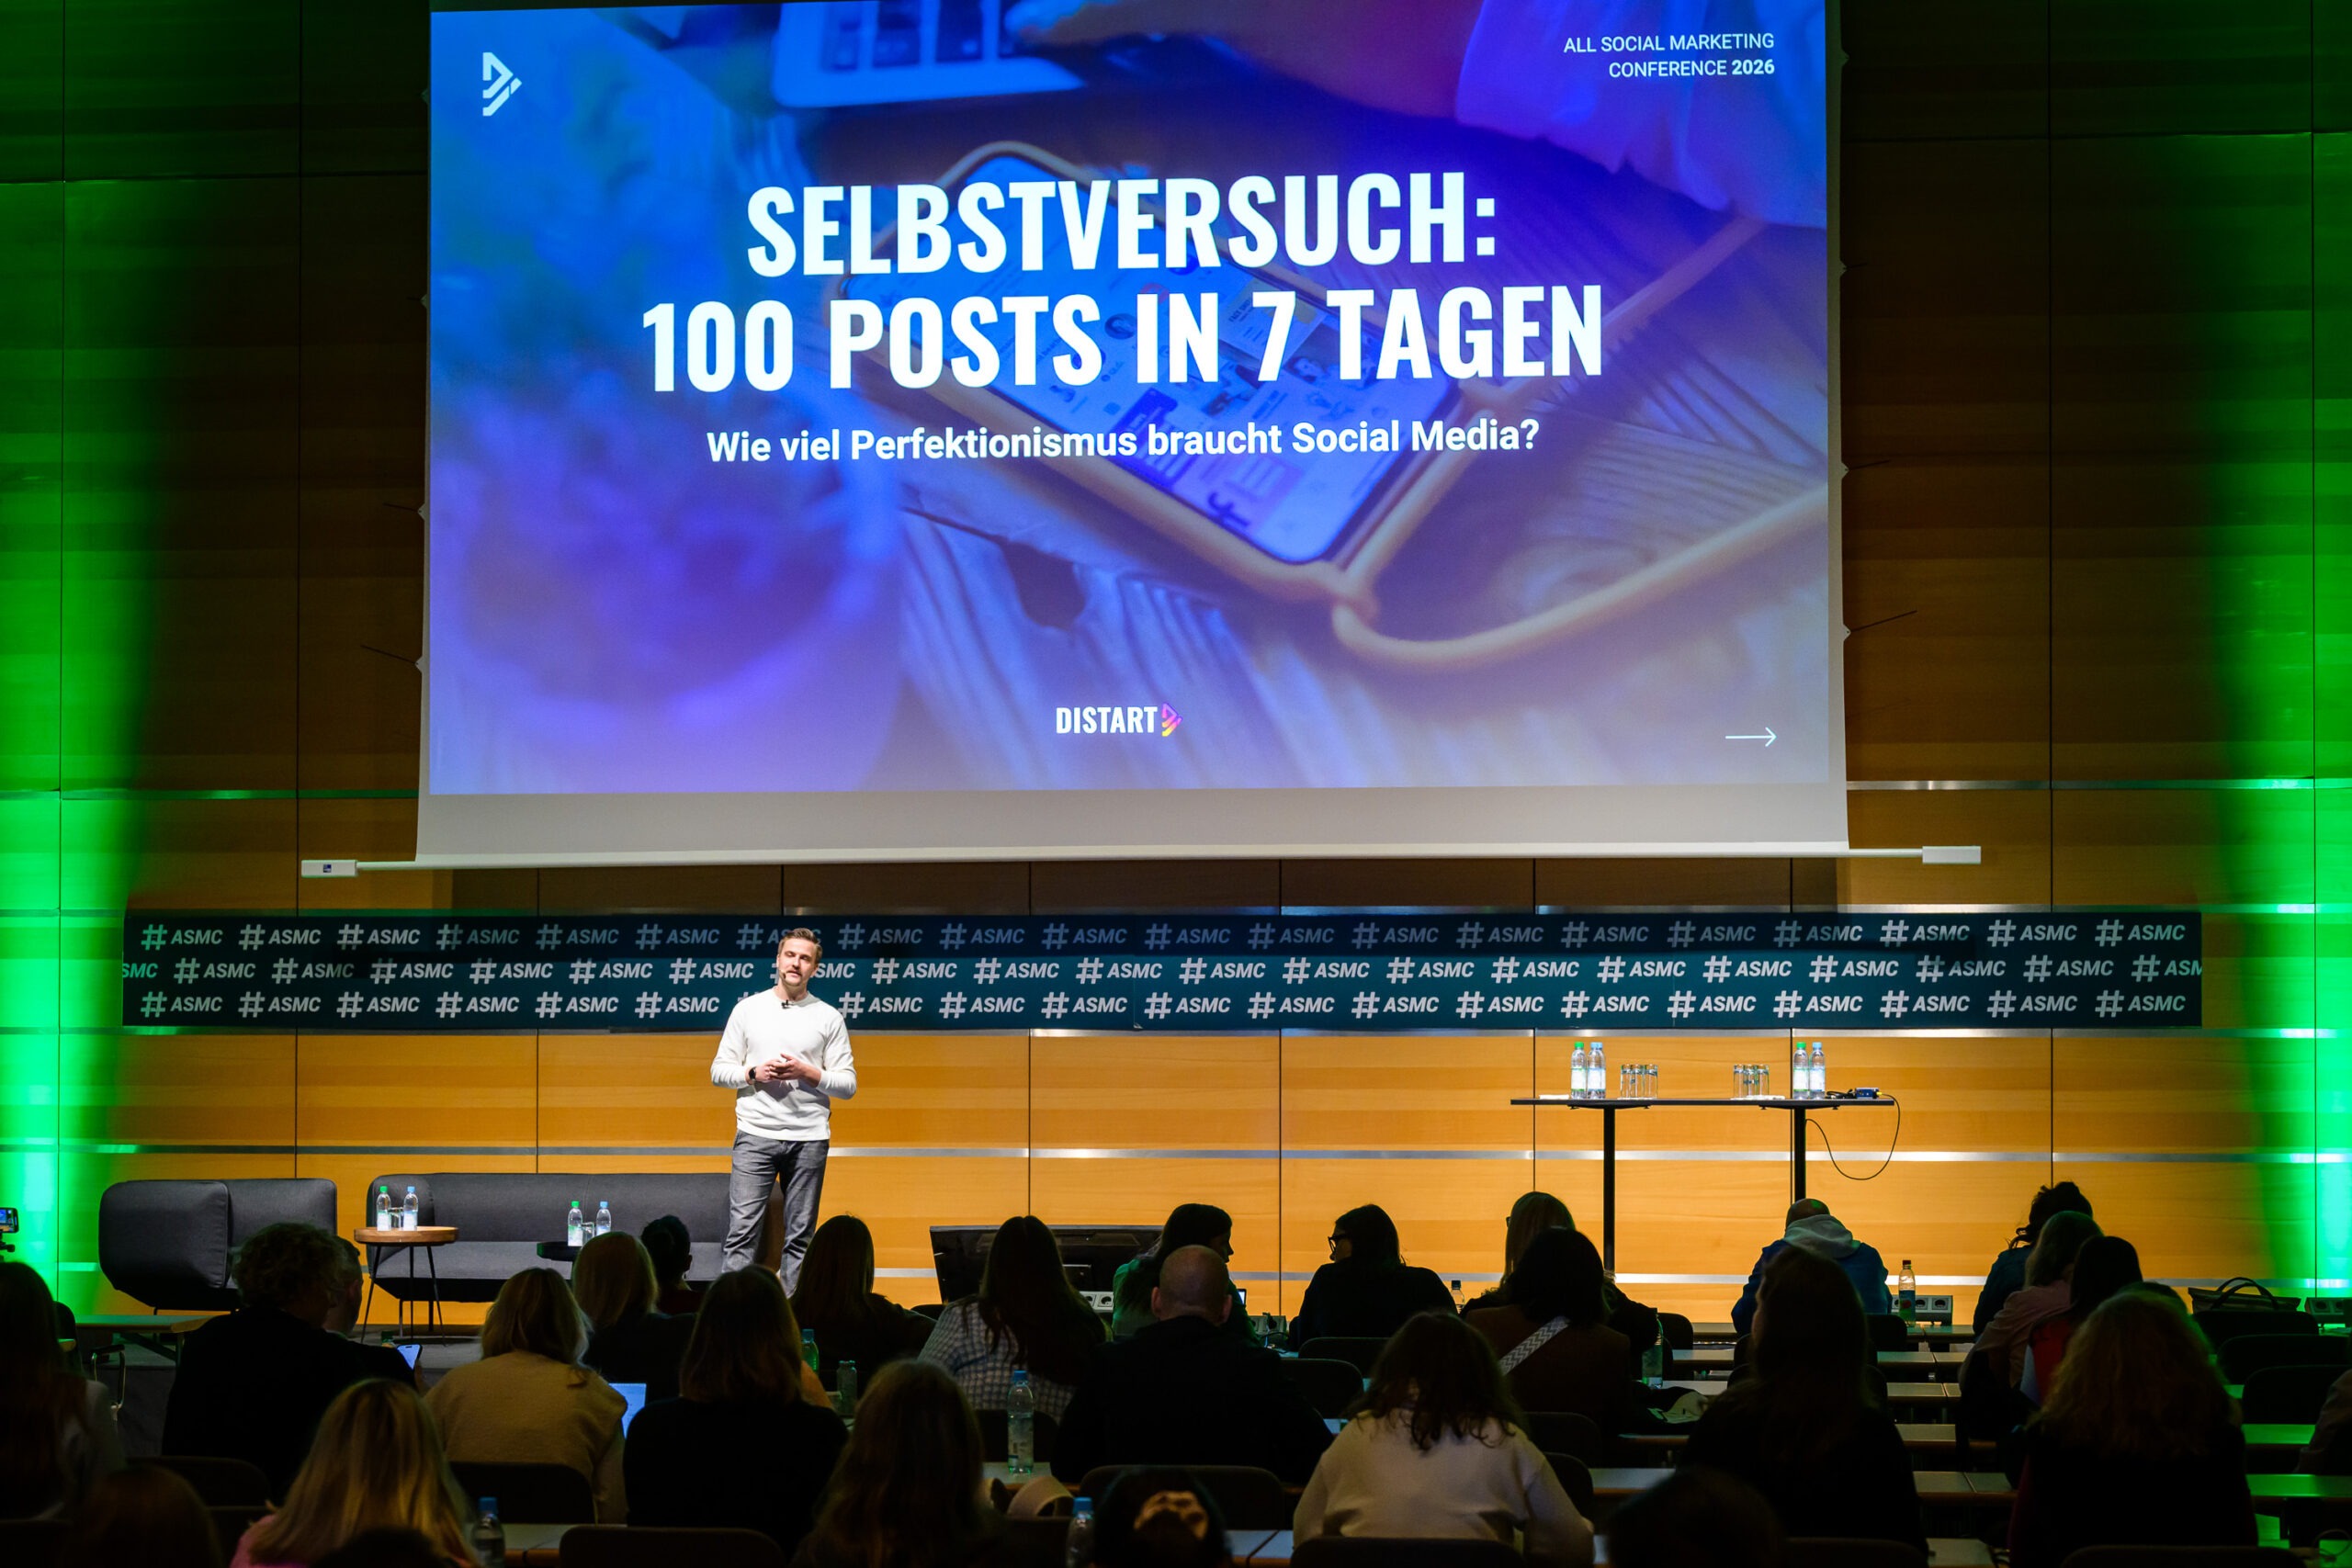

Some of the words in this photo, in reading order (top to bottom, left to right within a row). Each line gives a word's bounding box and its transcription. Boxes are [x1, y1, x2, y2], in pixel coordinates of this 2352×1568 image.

[1564, 37, 1597, 52] ALL
[1600, 35, 1666, 51] SOCIAL
[1669, 32, 1775, 51] MARKETING
[1609, 60, 1727, 78] CONFERENCE
[1731, 59, 1775, 74] 2026
[747, 172, 1497, 278] SELBSTVERSUCH:
[642, 300, 794, 393] 100
[830, 293, 1102, 389] POSTS
[1136, 292, 1219, 384] IN
[1251, 290, 1296, 382] 7
[1326, 285, 1602, 381] TAGEN
[707, 431, 771, 462] Wie
[780, 428, 840, 461] viel
[851, 425, 1137, 460] Perfektionismus
[1148, 422, 1283, 456] braucht
[1291, 420, 1400, 454] Social
[1411, 417, 1541, 451] Media?
[1056, 706, 1159, 734] DISTART
